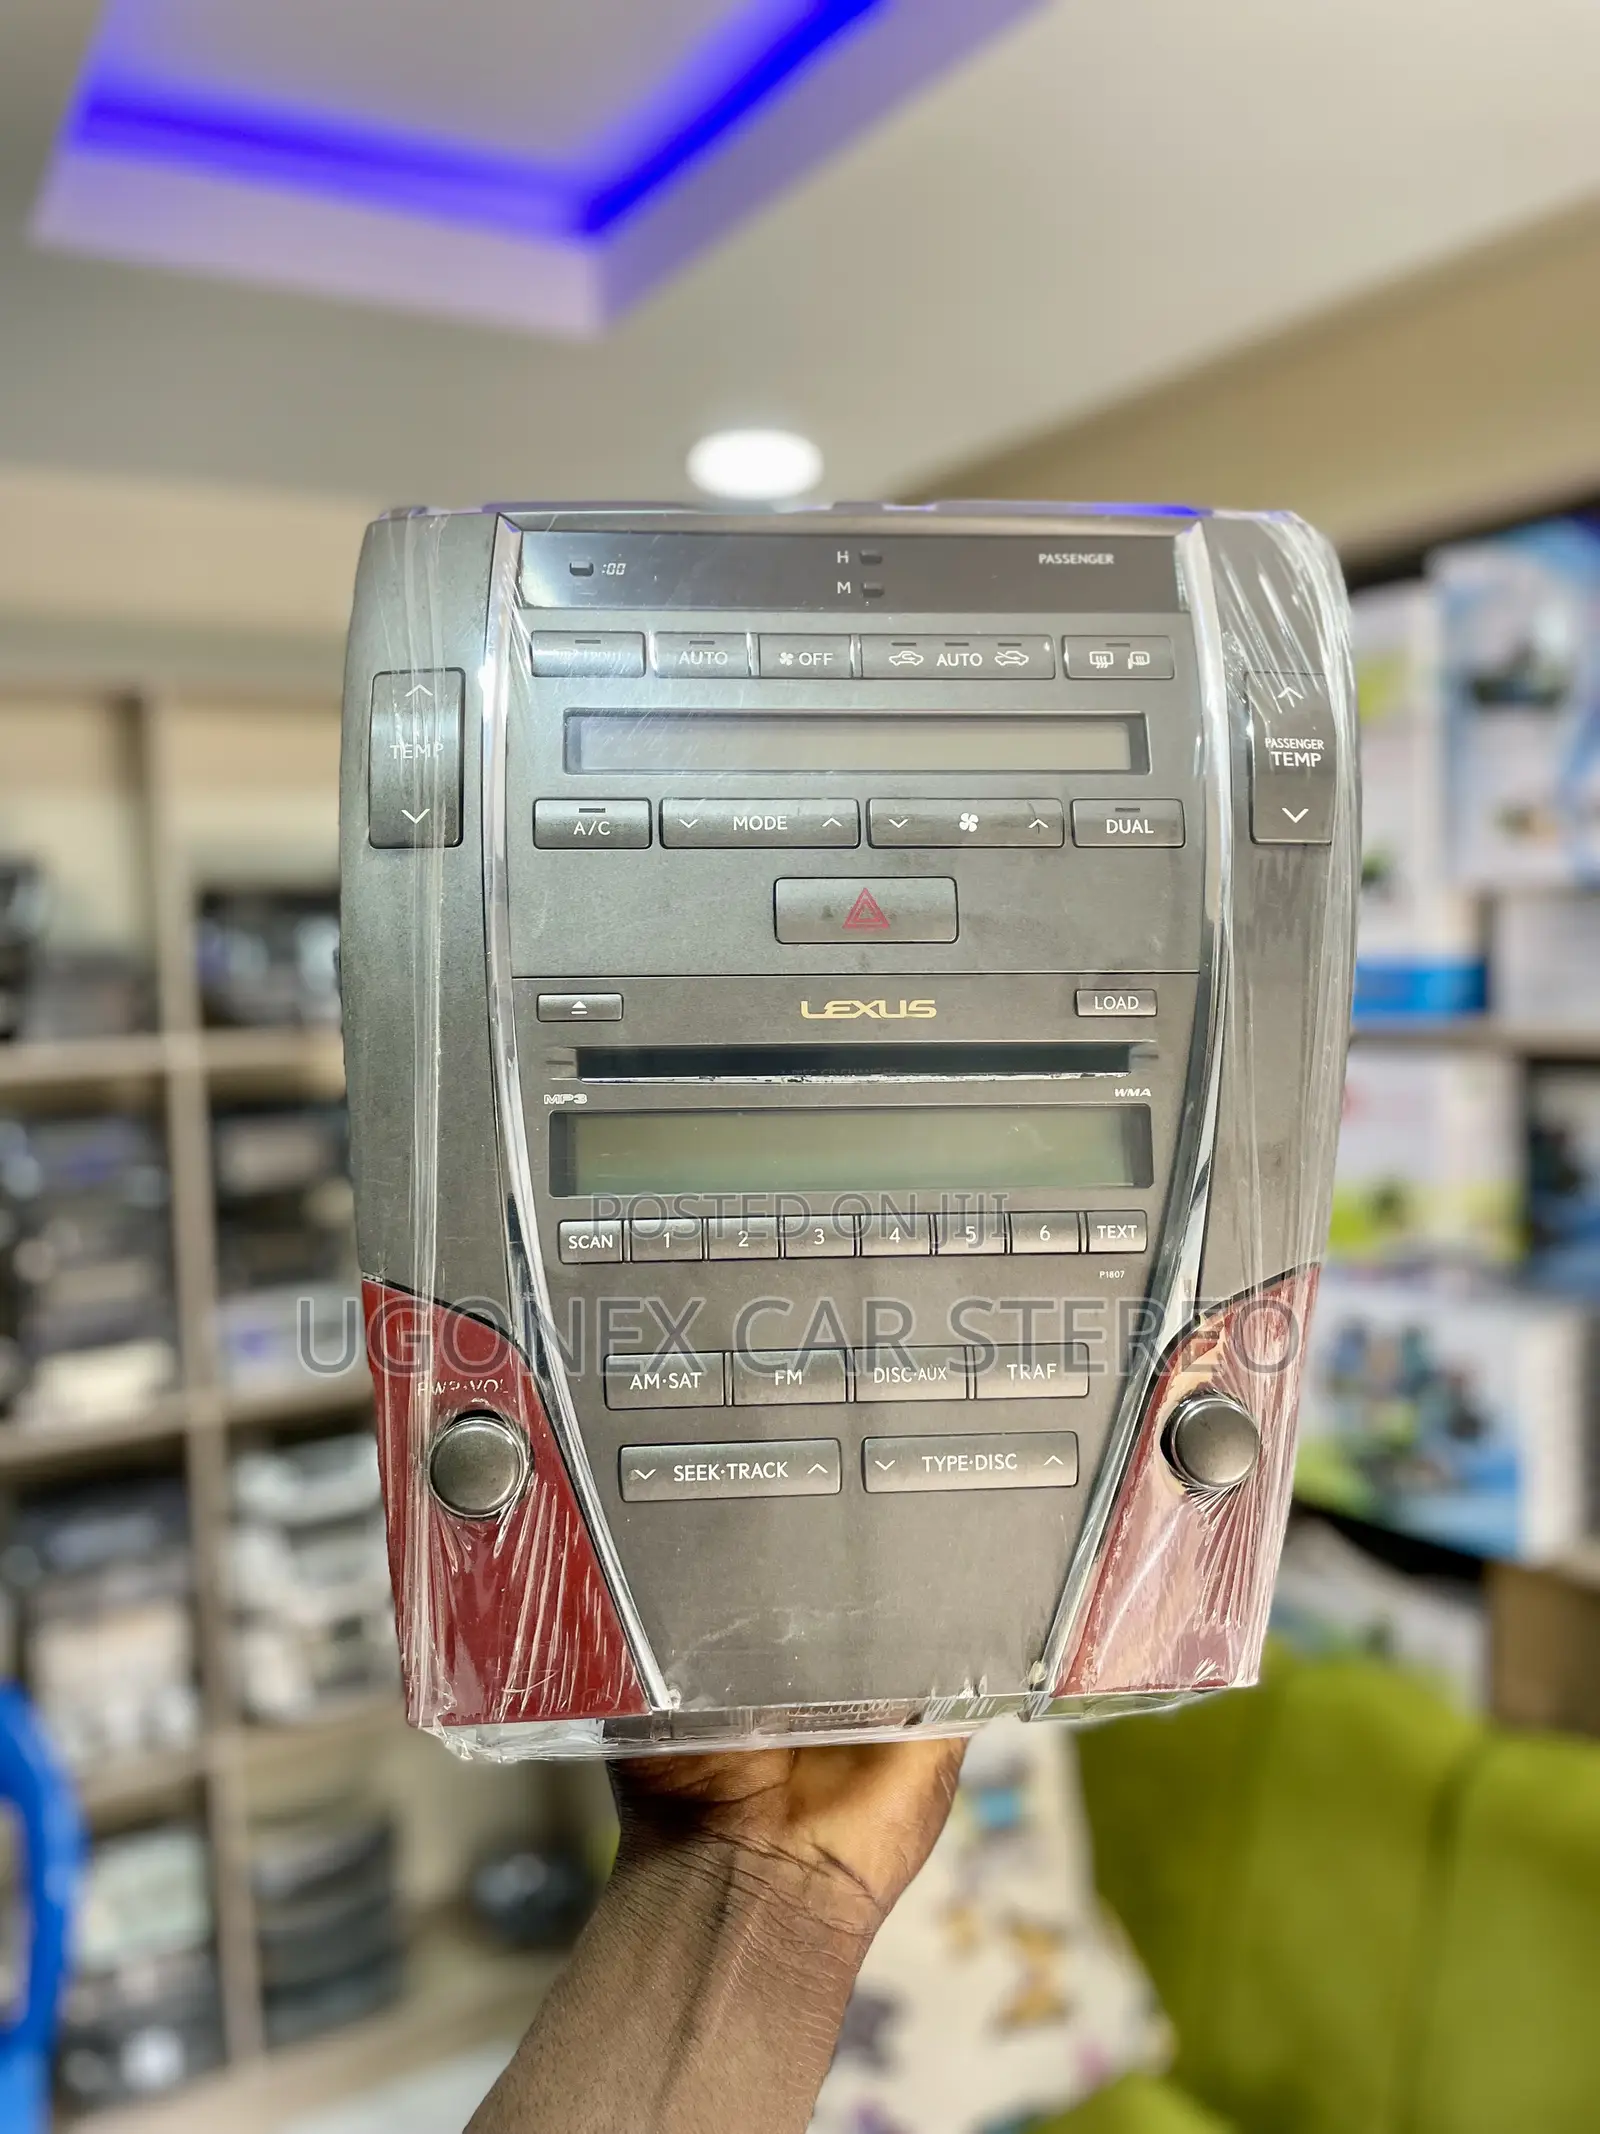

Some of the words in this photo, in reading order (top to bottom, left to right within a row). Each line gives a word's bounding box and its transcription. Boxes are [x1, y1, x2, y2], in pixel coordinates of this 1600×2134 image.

[837, 551, 848, 563] H
[1038, 553, 1114, 565] PASSENGER
[837, 581, 851, 594] M
[679, 651, 728, 666] AUTO
[798, 652, 834, 666] OFF
[936, 652, 983, 667] AUTO
[389, 741, 444, 759] TEMP
[1264, 737, 1325, 752] PASSENGER
[1271, 751, 1322, 768] TEMP
[573, 820, 613, 836] A/C
[733, 815, 788, 831] MODE
[1106, 819, 1155, 834] DUAL
[800, 999, 938, 1019] LEXUS
[1094, 995, 1140, 1011] LOAD
[544, 1093, 588, 1105] MP3
[1114, 1088, 1152, 1098] WMA
[663, 1231, 672, 1248] 1
[738, 1231, 749, 1248] 2
[813, 1228, 825, 1245] 3
[889, 1227, 901, 1244] 4
[965, 1225, 977, 1242] 5
[1039, 1225, 1051, 1242] 6
[1097, 1225, 1138, 1240] TEXT
[568, 1234, 613, 1250] SCAN
[1099, 1270, 1125, 1279] P1807
[774, 1369, 803, 1386] FM
[1006, 1363, 1057, 1381] TRAF
